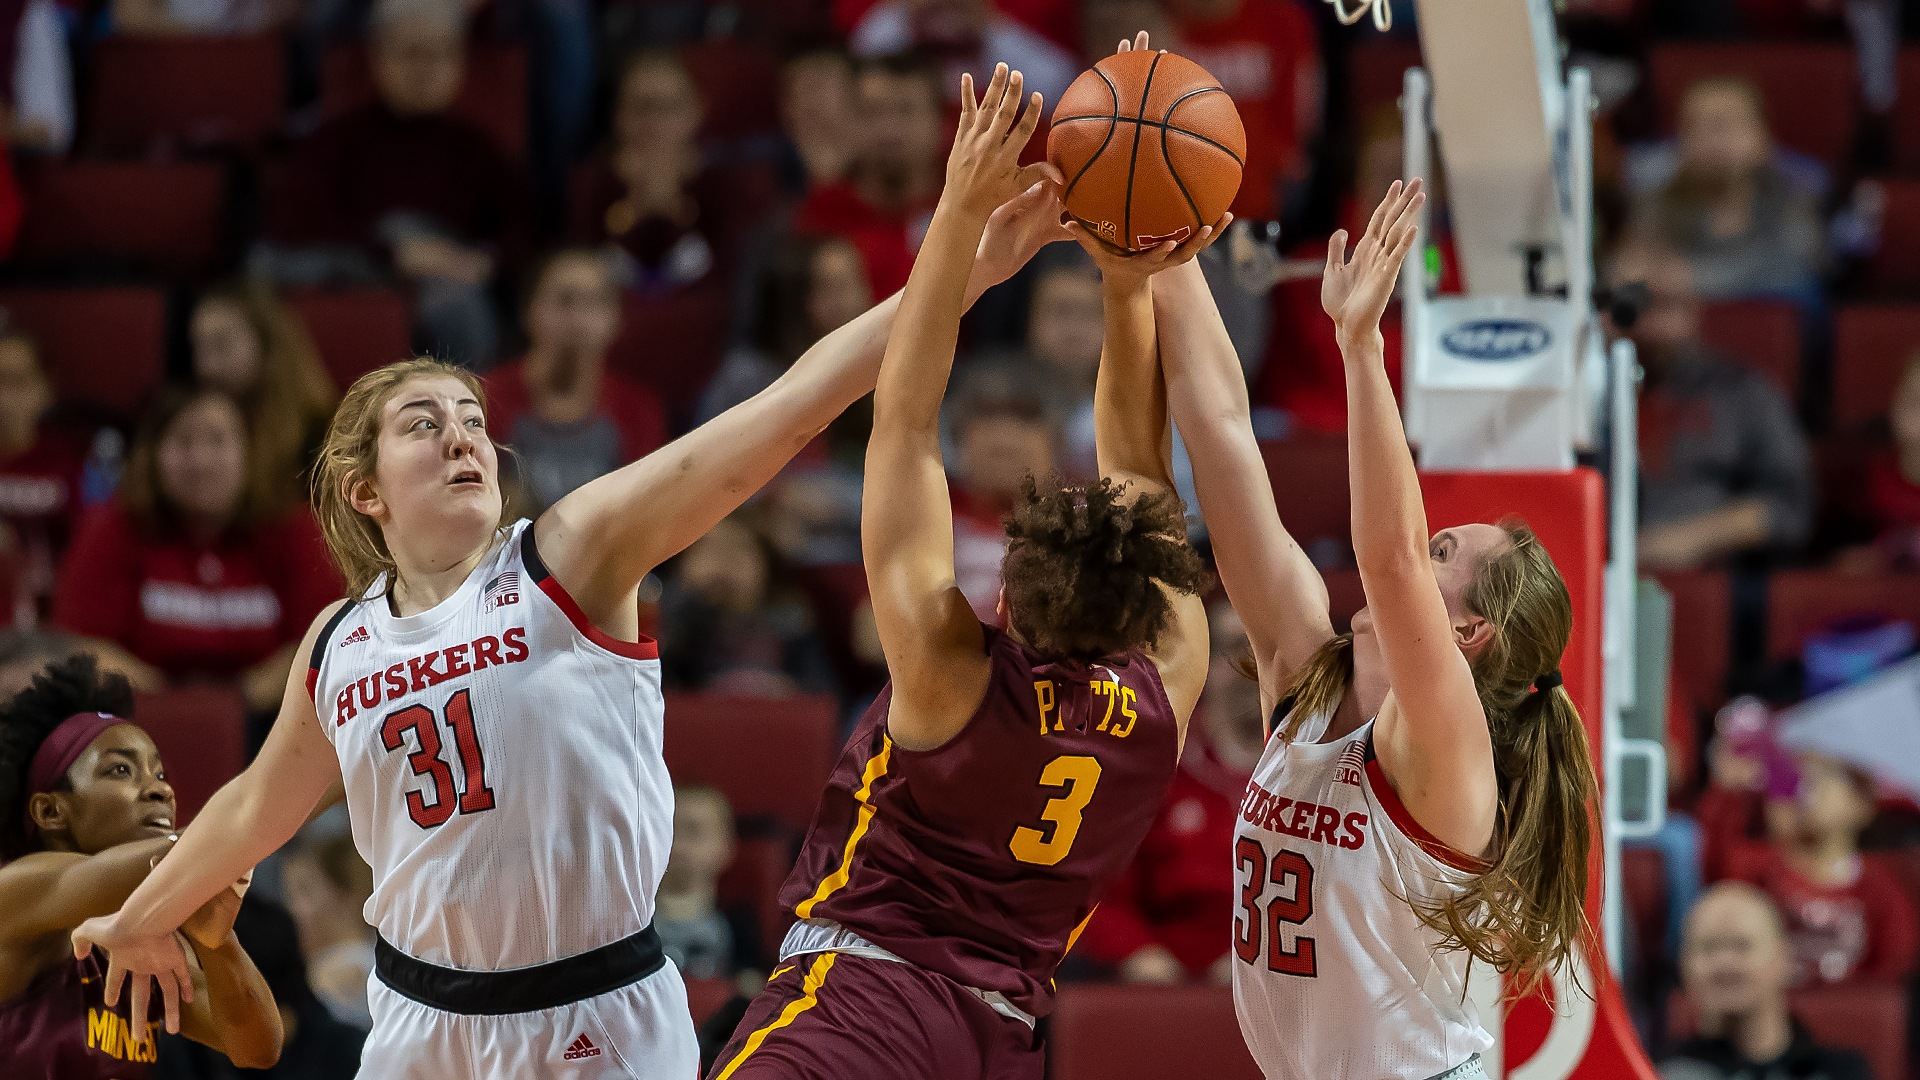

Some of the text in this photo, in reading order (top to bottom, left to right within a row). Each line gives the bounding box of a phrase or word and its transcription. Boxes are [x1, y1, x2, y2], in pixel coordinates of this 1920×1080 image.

[336, 627, 529, 727] HUSKERS
[1034, 680, 1137, 737] PTS
[380, 687, 496, 829] 31
[1009, 755, 1102, 867] 3
[1238, 780, 1368, 850] USKERS
[1233, 834, 1317, 978] 32
[563, 1046, 601, 1060] adidas
